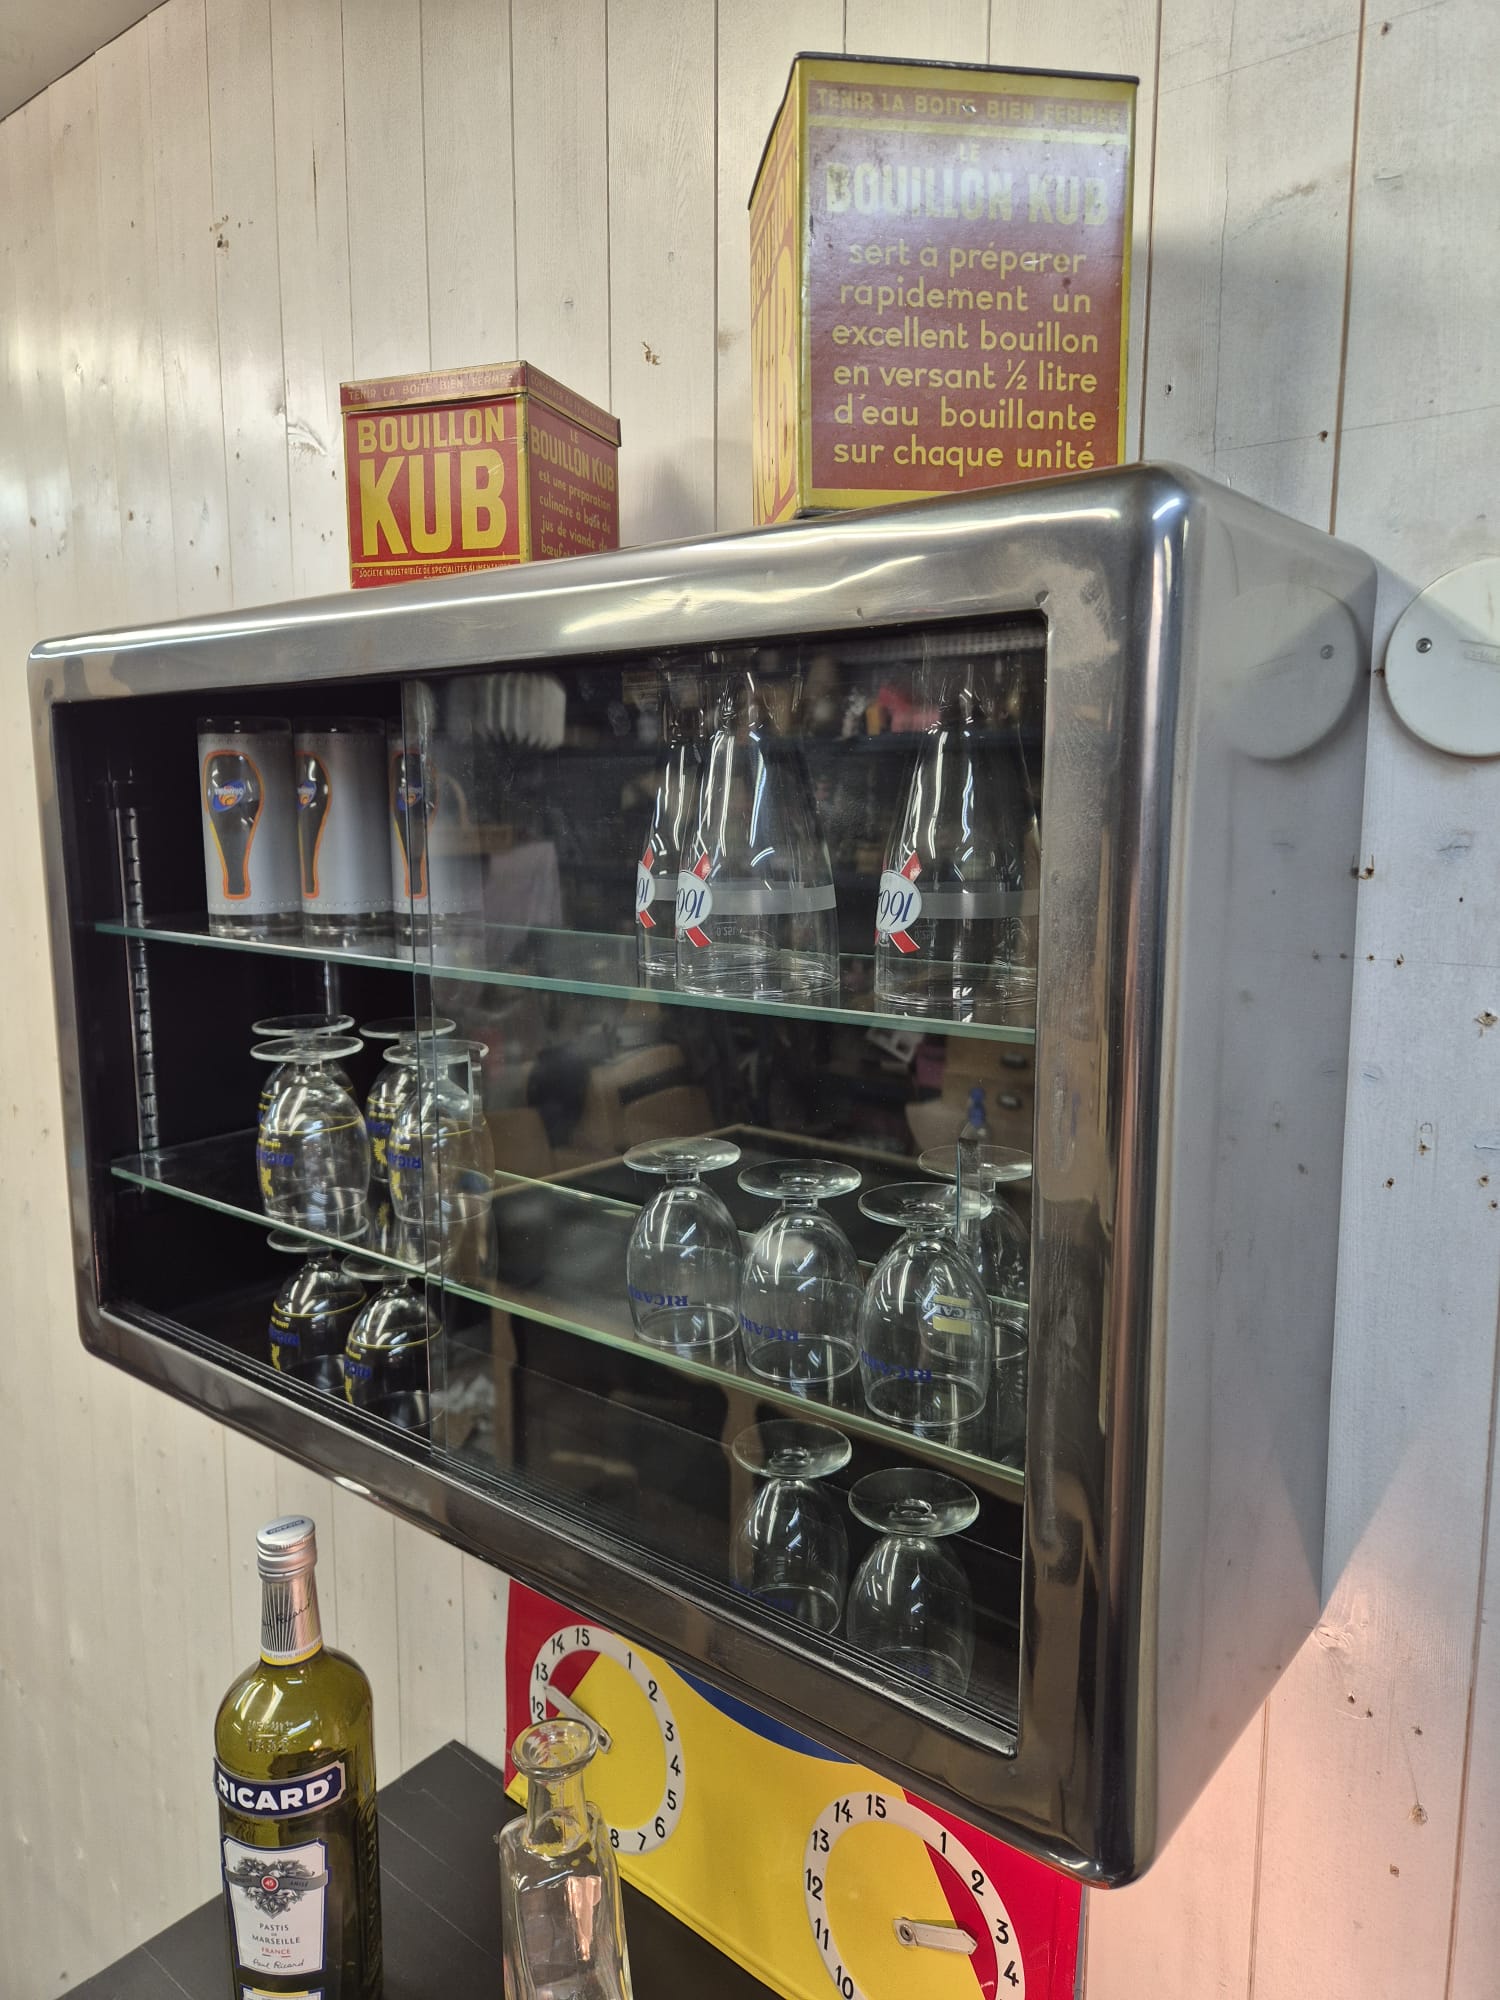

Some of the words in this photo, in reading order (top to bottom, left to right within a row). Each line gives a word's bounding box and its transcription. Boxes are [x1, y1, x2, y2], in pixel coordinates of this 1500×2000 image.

[817, 88, 873, 111] TENIR
[881, 93, 905, 113] LA
[987, 100, 1035, 121] BIEN
[959, 142, 980, 162] LE
[825, 161, 1014, 223] BOUILLON
[1028, 173, 1110, 226] KUB
[849, 238, 911, 268] sert
[919, 238, 938, 268] à
[950, 241, 1087, 280] préparer
[839, 276, 1030, 315] rapidement
[1052, 292, 1092, 314] un
[832, 315, 969, 350] excellent
[980, 319, 1099, 354] bouillon
[384, 386, 396, 397] LA
[439, 378, 464, 391] BIEN
[833, 364, 869, 386] en
[879, 361, 997, 391] versant
[1038, 360, 1099, 394] litre
[833, 393, 919, 427] d'eau
[941, 395, 1097, 431] bouillante
[357, 406, 506, 454] BOUILLON
[570, 429, 579, 444] LE
[530, 424, 590, 481] BOUILLON
[592, 456, 615, 493] KUB
[833, 442, 885, 465] sur
[893, 433, 1004, 477] chaque
[1016, 440, 1096, 470] unité
[538, 470, 551, 484] est
[553, 477, 567, 491] une
[358, 448, 508, 556] KUB
[540, 491, 574, 518] culinaire
[541, 514, 554, 535] jus
[557, 520, 567, 538] de
[569, 528, 596, 550] viande
[552, 1634, 565, 1655] 14
[575, 1627, 590, 1646] 15
[535, 1662, 549, 1682] 13
[626, 1652, 633, 1670] 1
[648, 1680, 658, 1702] 2
[532, 1696, 545, 1721] 12
[665, 1720, 674, 1742] 3
[670, 1755, 681, 1776] 4
[217, 1771, 330, 1811] RICARD
[667, 1790, 677, 1811] 5
[834, 1799, 853, 1823] 14
[865, 1793, 887, 1819] 15
[610, 1828, 620, 1849] 8
[655, 1816, 666, 1838] 6
[637, 1832, 647, 1851] 7
[812, 1828, 830, 1853] 13
[940, 1831, 947, 1854] 1
[805, 1868, 824, 1901] 12
[971, 1870, 985, 1896] 2
[252, 1933, 301, 1945] MARSEILLE
[259, 1922, 289, 1932] PASTIS
[814, 1918, 829, 1951] 11
[995, 1919, 1009, 1945] 3
[261, 1946, 291, 1955] FRANCE
[835, 1965, 854, 2000] 10
[1003, 1960, 1020, 1987] 4
